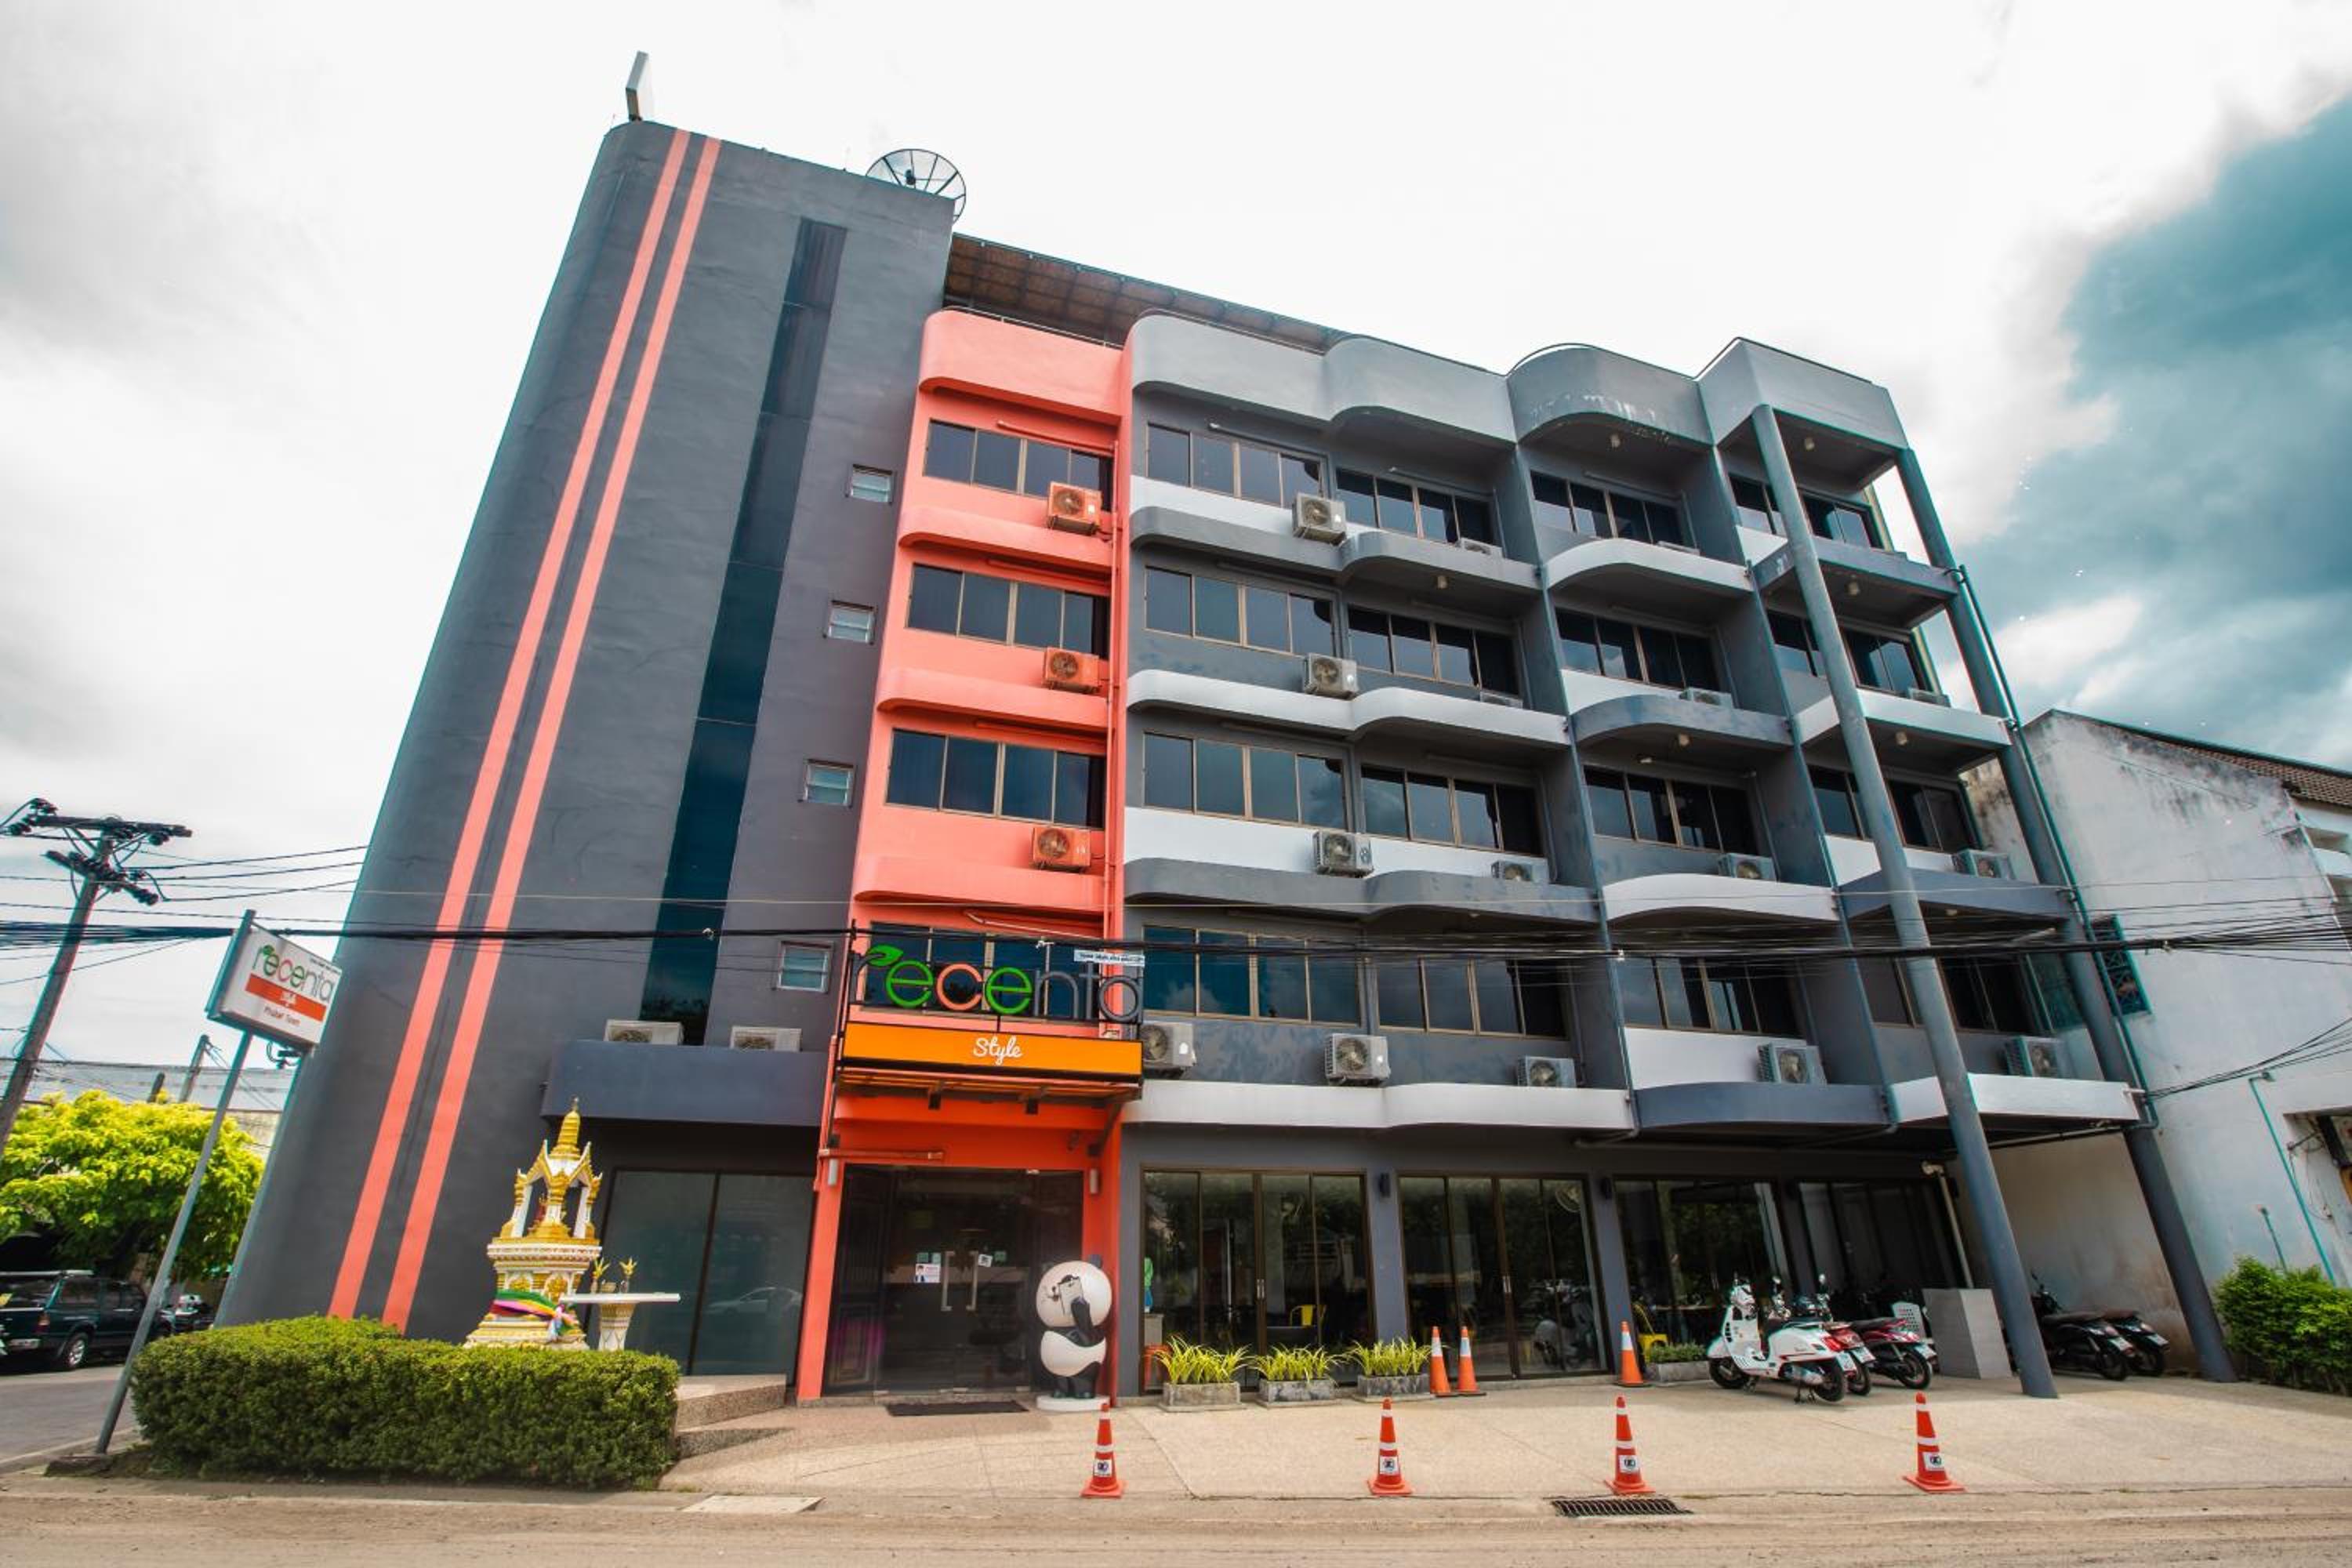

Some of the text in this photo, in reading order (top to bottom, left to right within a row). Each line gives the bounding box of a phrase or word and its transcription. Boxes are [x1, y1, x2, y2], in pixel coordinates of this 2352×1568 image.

[252, 945, 334, 1003] recenta
[850, 944, 1143, 1021] recenta
[973, 1036, 1022, 1065] Style
